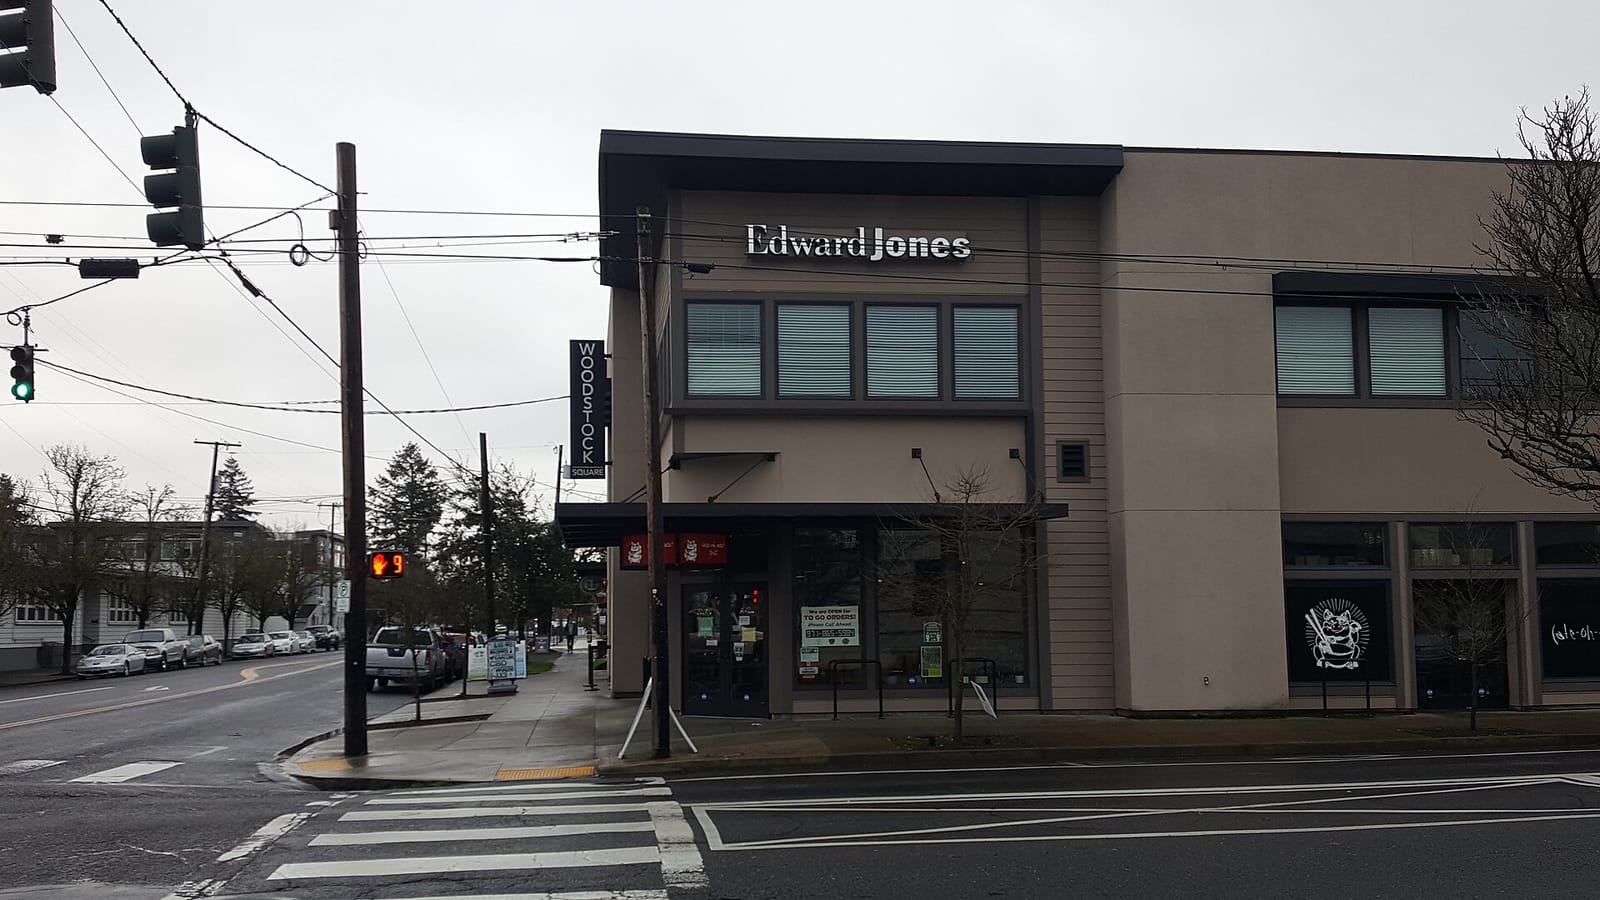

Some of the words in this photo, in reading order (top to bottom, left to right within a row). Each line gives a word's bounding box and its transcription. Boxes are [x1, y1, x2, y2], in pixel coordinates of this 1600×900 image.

[745, 223, 868, 256] Edward
[869, 227, 971, 261] Jones
[579, 343, 595, 463] WOODSTOCK
[571, 468, 604, 476] SQUARE
[393, 555, 402, 573] 9
